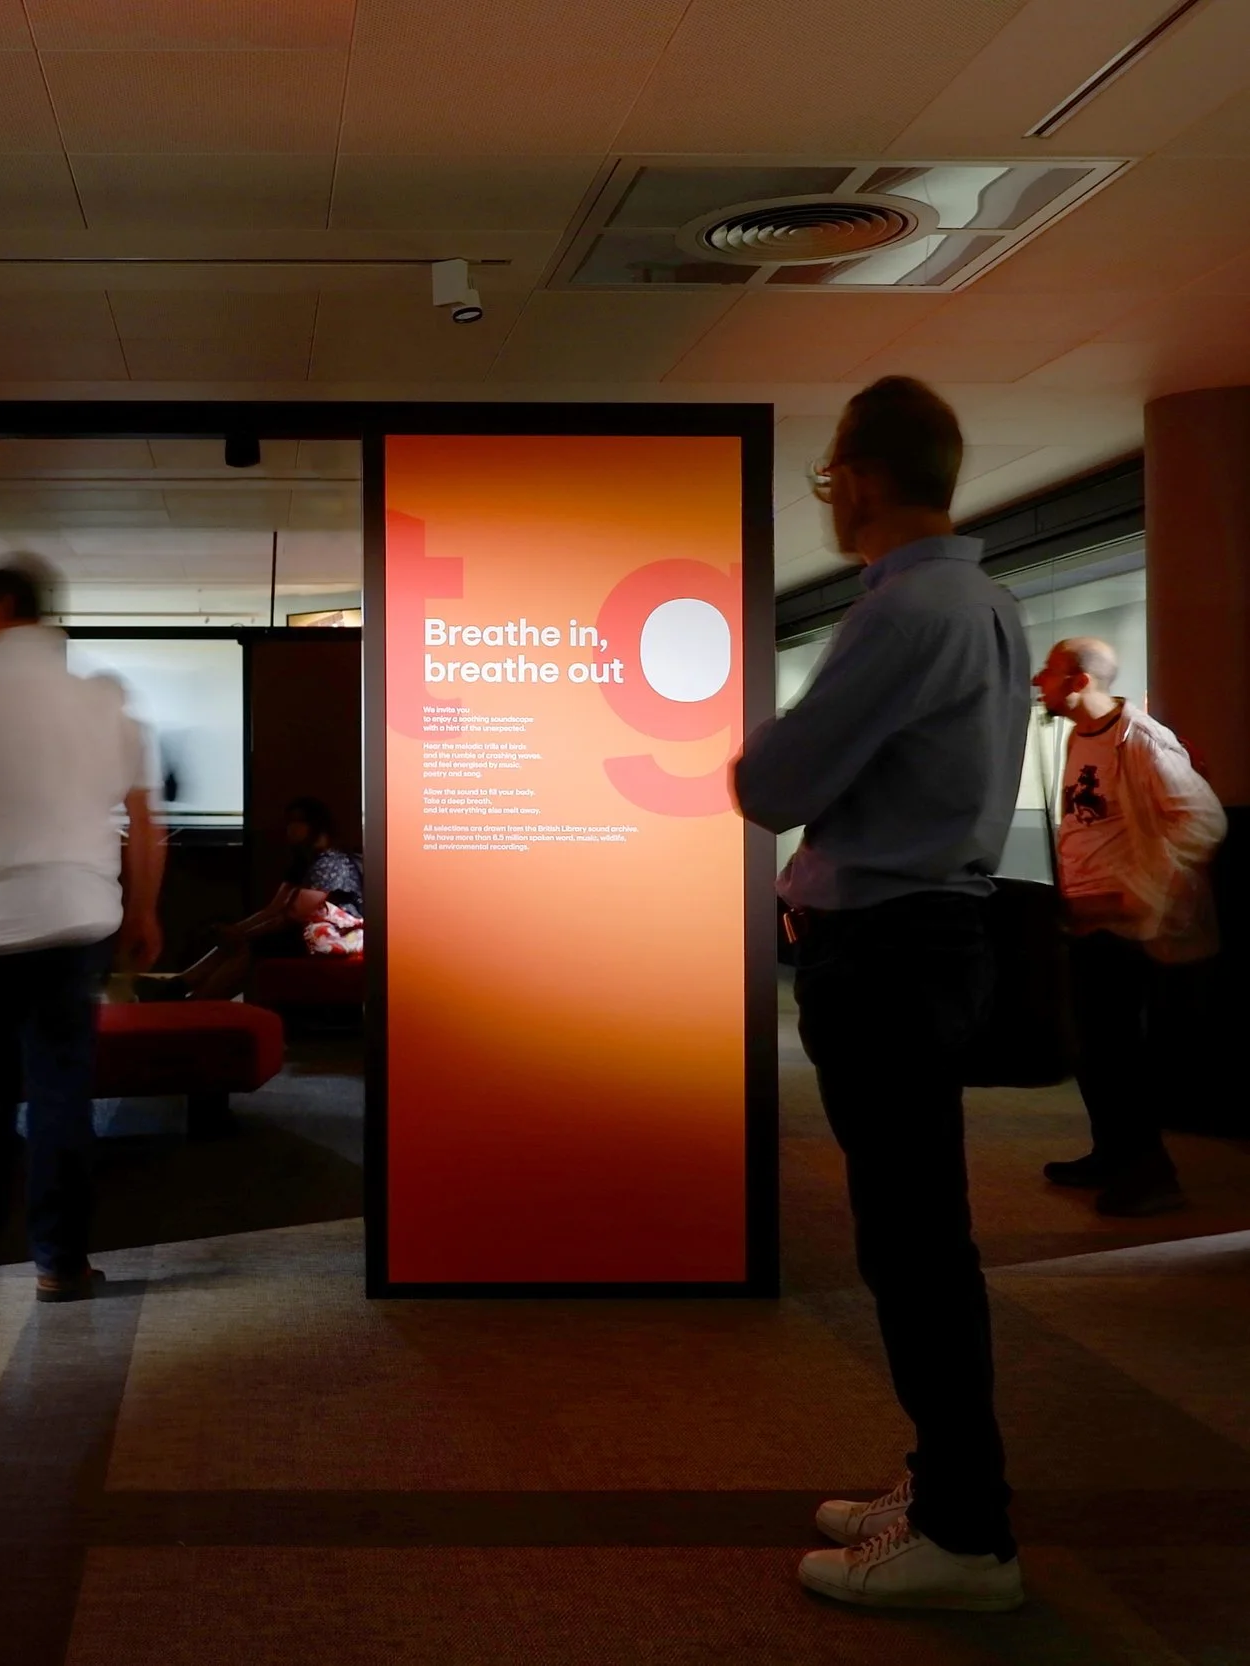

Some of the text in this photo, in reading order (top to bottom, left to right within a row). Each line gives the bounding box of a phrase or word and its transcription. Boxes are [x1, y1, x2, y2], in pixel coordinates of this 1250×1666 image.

[424, 618, 608, 652] Breathe in,
[424, 653, 624, 684] breathe out
